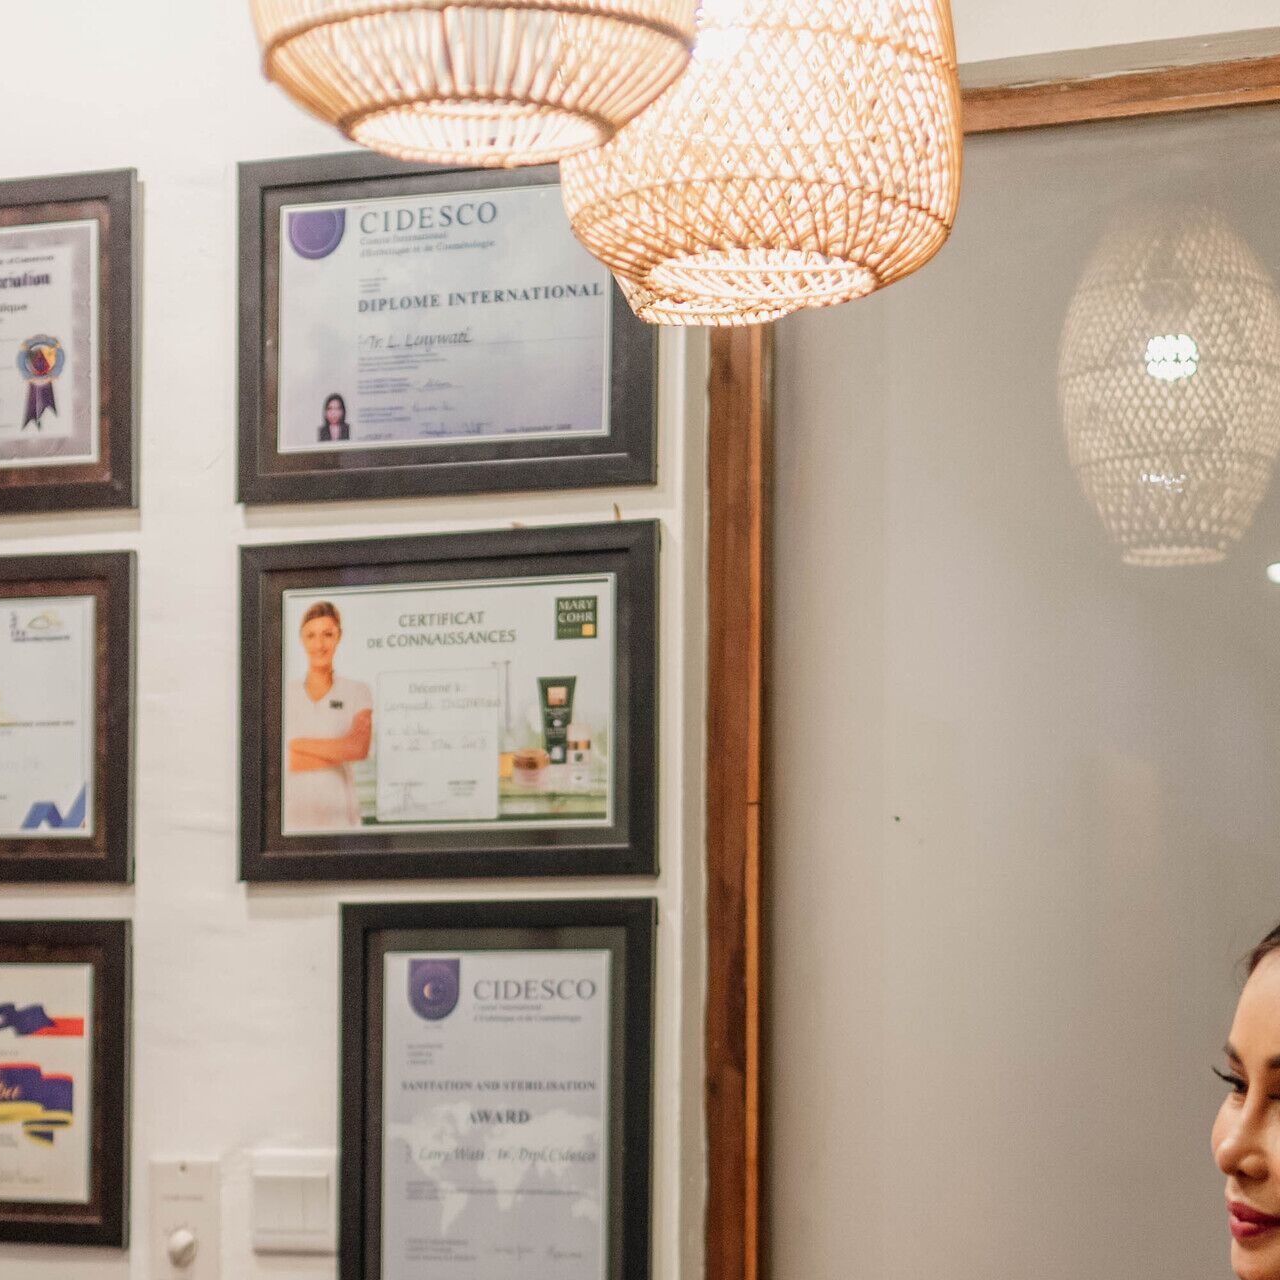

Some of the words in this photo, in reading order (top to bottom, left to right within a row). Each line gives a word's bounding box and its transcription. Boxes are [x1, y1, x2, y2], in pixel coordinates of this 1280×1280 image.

[360, 201, 497, 234] CIDESCO
[358, 294, 440, 313] DIPLOME
[448, 282, 604, 307] INTERNATIONAL
[558, 600, 594, 611] MARY
[398, 611, 485, 628] CERTIFICAT
[558, 611, 594, 624] COHR
[367, 637, 384, 649] DE
[386, 629, 516, 648] CONNAISSANCES
[473, 978, 597, 1000] CIDESCO
[470, 1109, 532, 1125] AWARD
